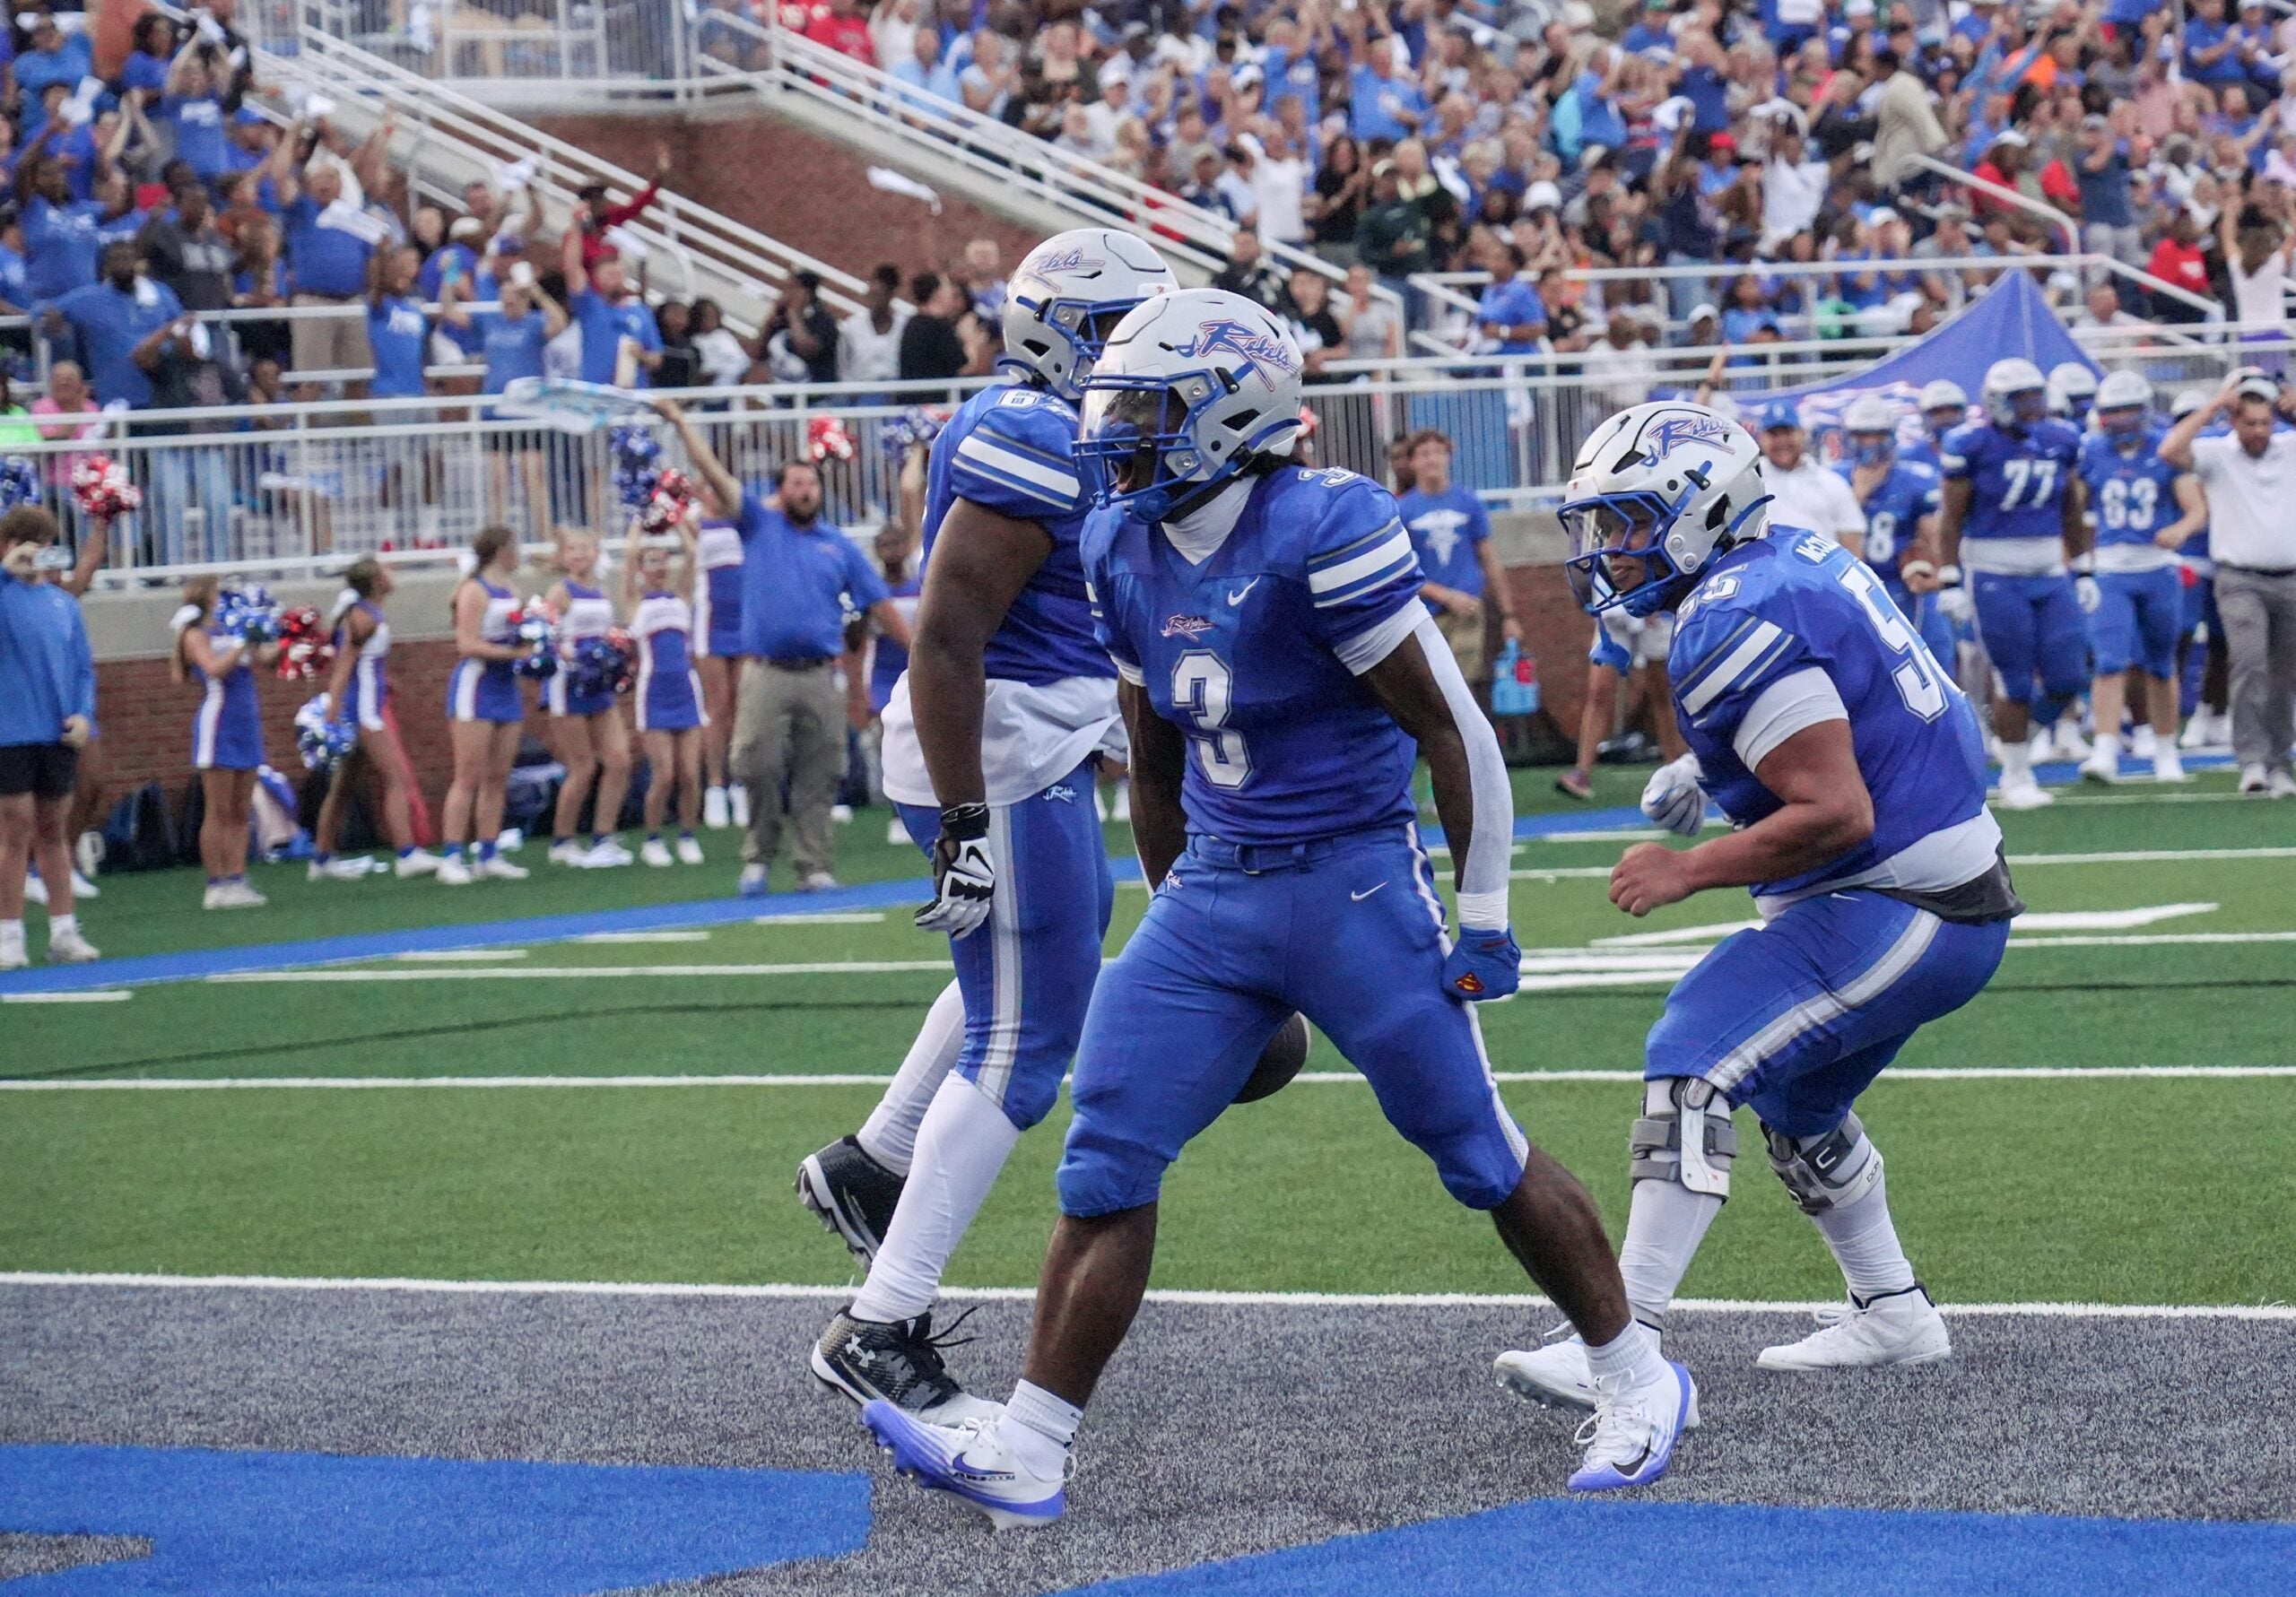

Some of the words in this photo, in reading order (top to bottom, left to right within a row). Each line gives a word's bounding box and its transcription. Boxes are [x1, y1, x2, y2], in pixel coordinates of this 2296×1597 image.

[1186, 319, 1300, 393] Rebels
[2000, 459, 2057, 511] 77
[2100, 477, 2159, 529] 63
[1867, 509, 1896, 563] 8
[1171, 648, 1254, 790] 3
